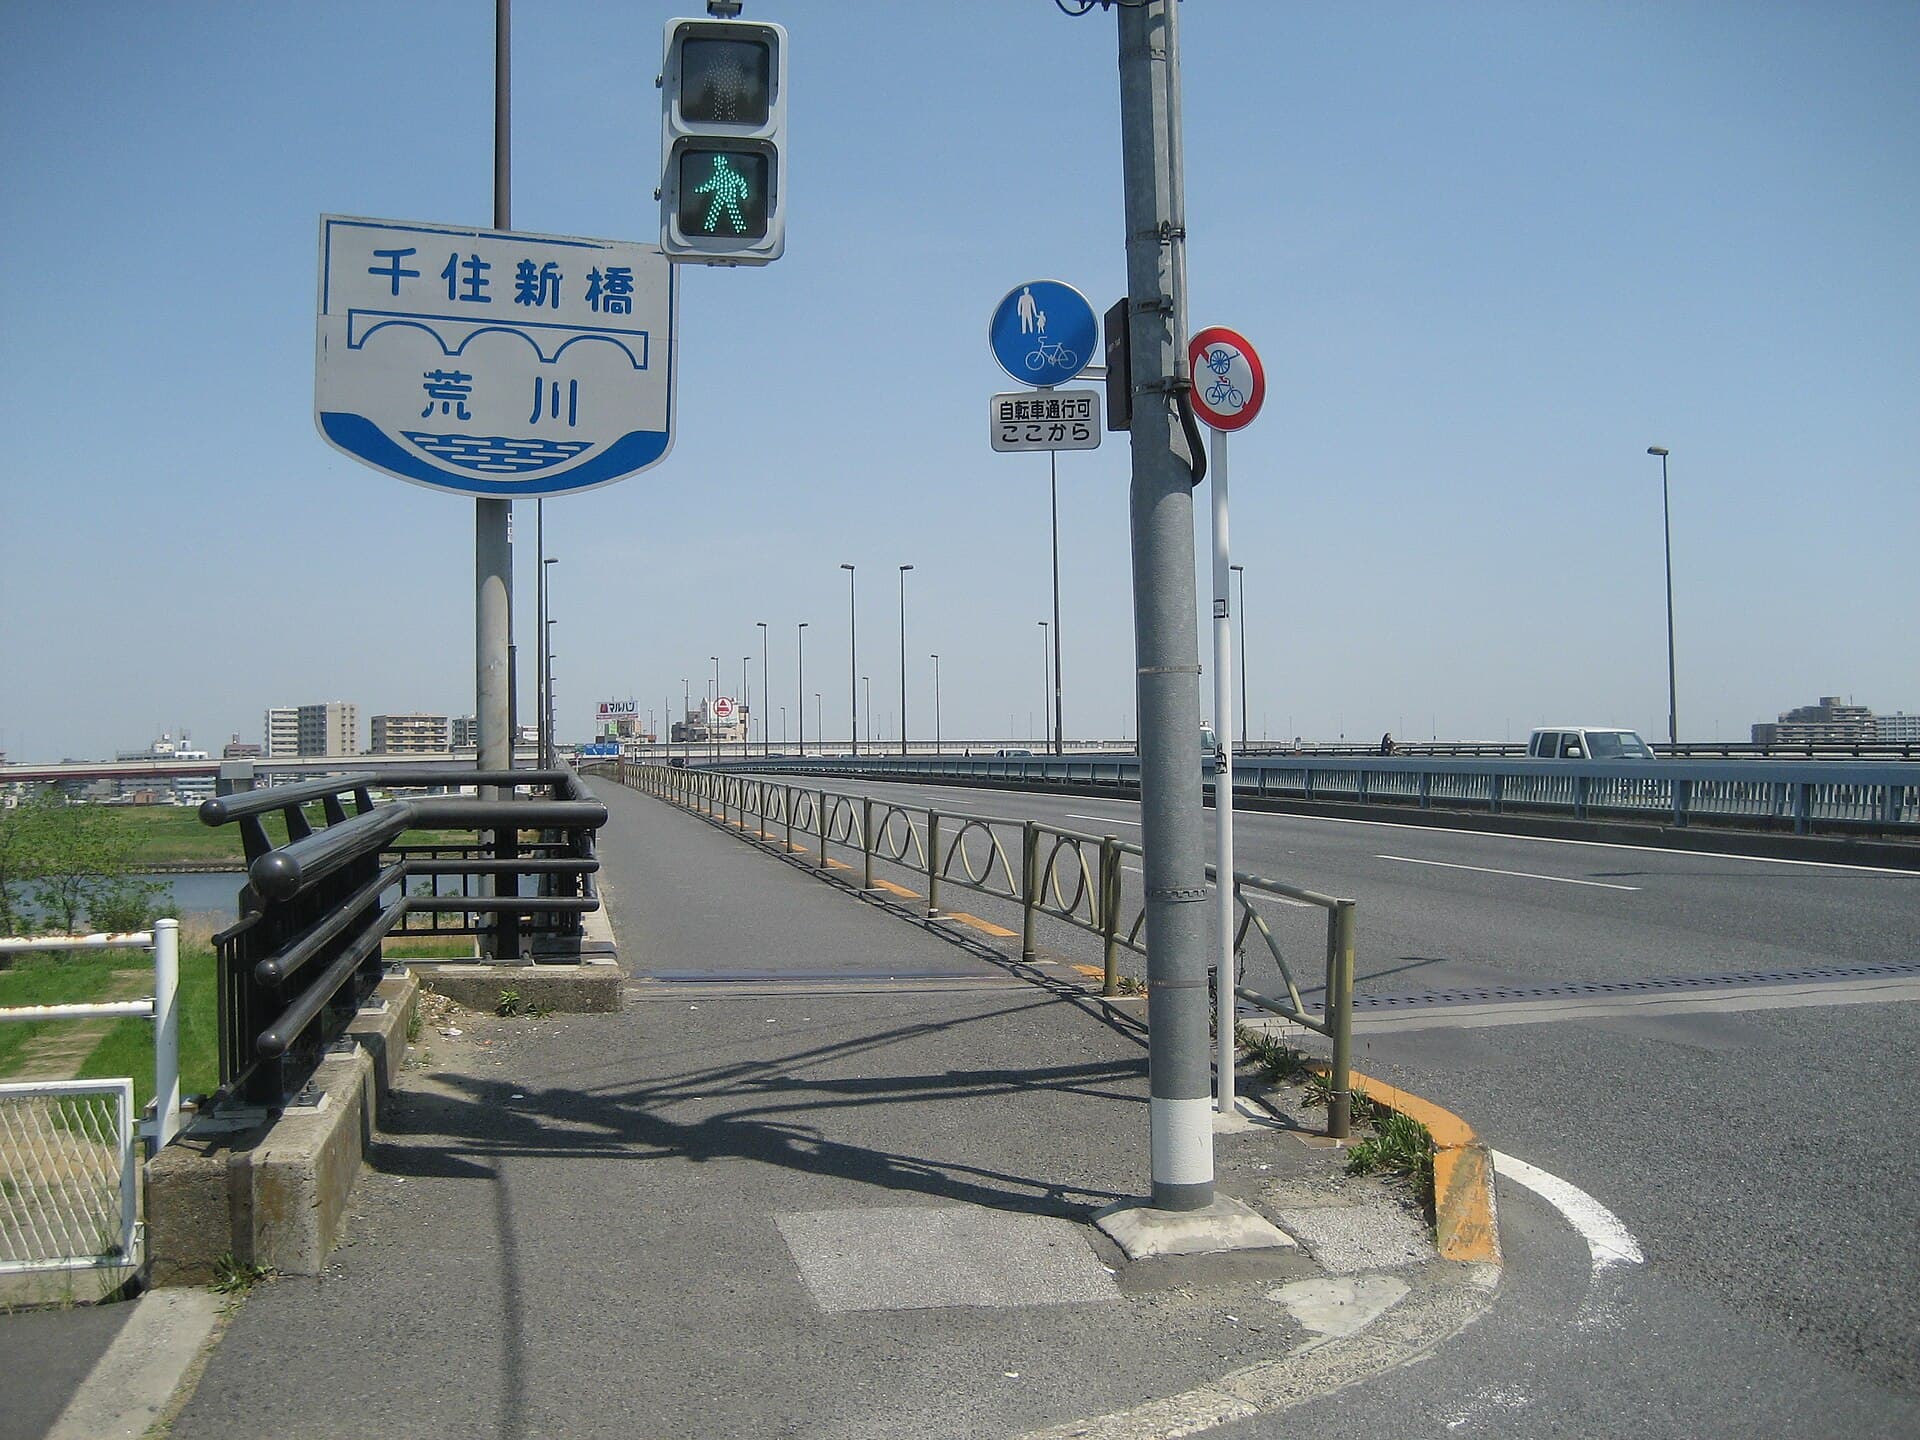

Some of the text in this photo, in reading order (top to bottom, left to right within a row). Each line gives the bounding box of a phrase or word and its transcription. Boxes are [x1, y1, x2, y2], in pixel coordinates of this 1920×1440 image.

[368, 248, 634, 315] 千住新橋
[421, 370, 578, 427] 荒川
[1000, 399, 1091, 420] 自転車通行可
[1002, 423, 1090, 442] ここから
